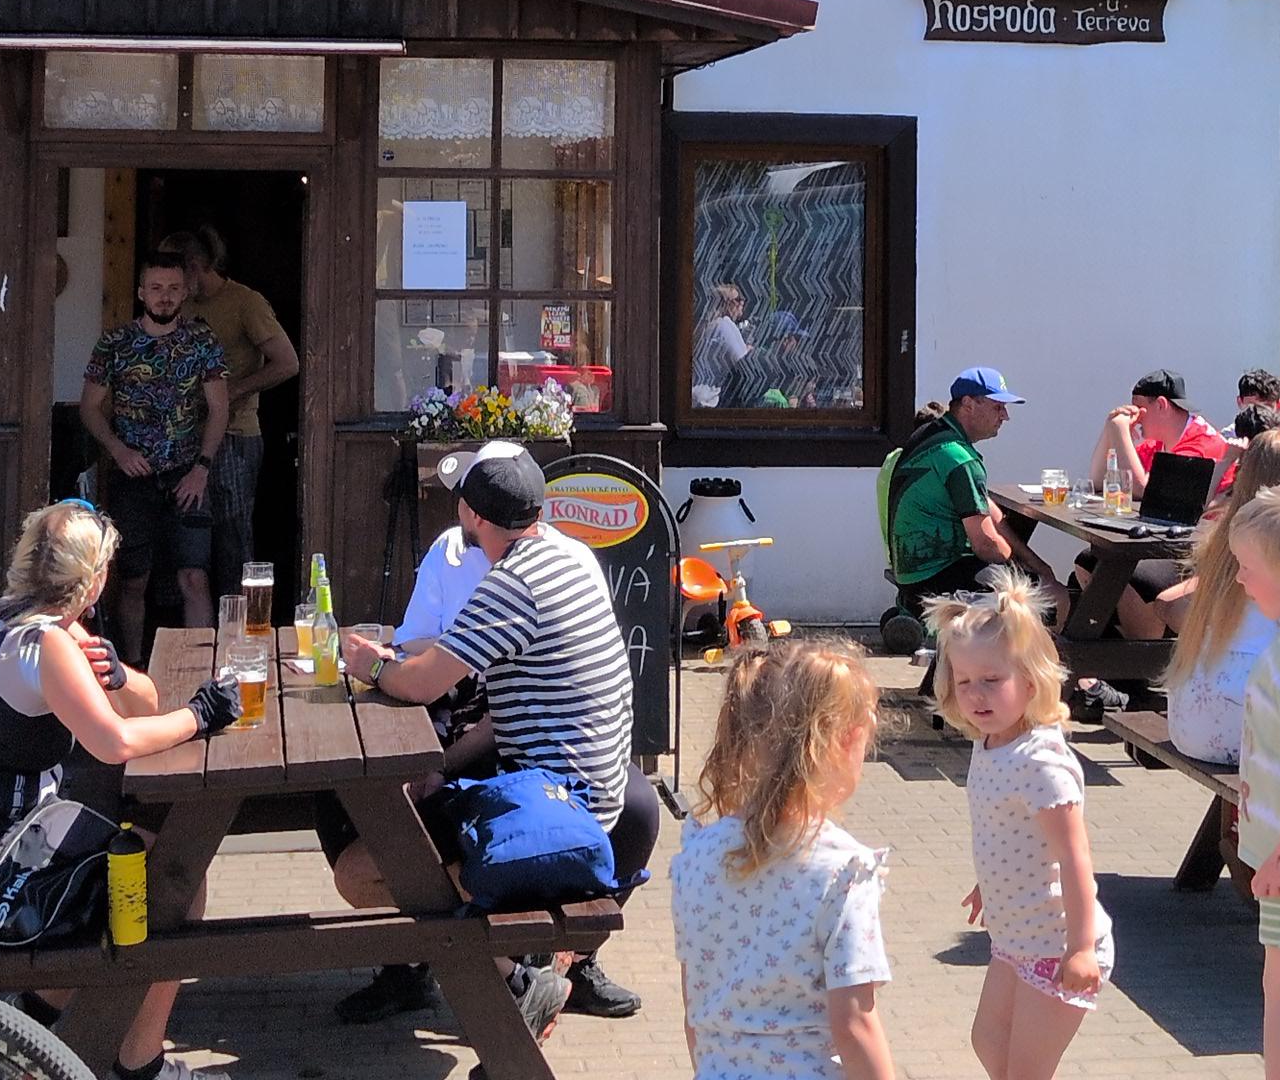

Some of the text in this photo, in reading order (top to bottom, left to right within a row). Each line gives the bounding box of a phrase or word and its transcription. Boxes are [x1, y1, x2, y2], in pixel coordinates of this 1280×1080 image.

[553, 335, 571, 344] ZDE
[549, 500, 628, 527] KONRAD
[608, 544, 655, 607] VÁ
